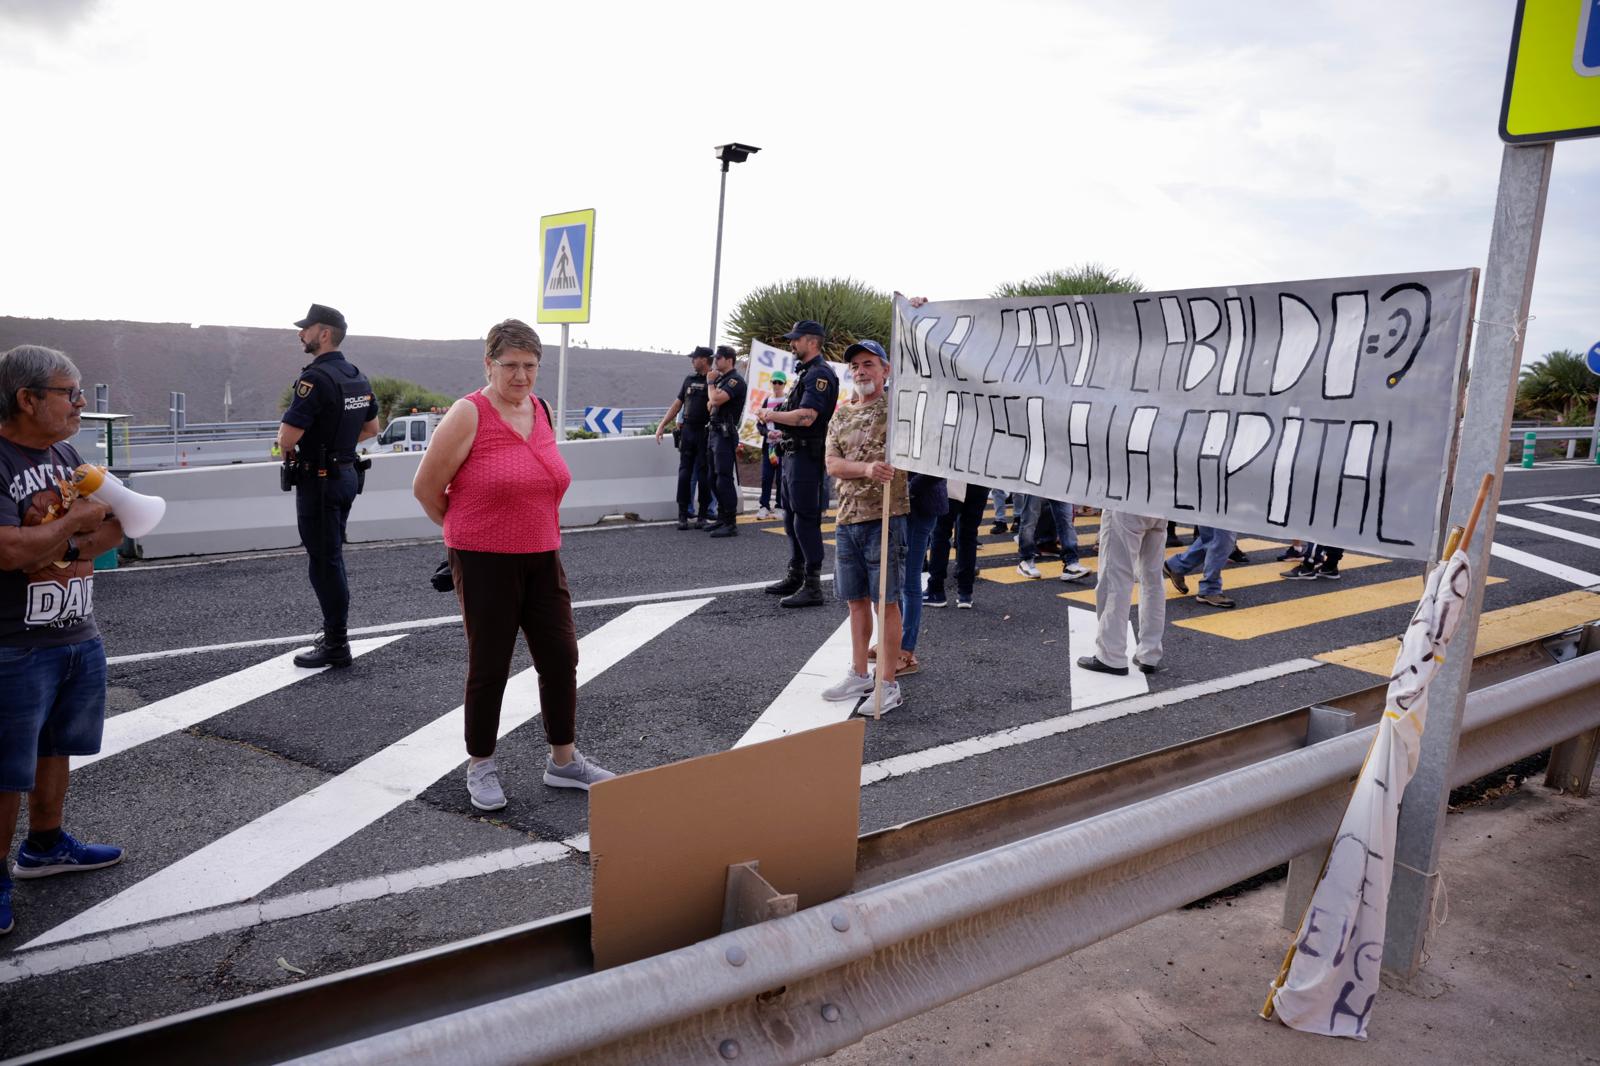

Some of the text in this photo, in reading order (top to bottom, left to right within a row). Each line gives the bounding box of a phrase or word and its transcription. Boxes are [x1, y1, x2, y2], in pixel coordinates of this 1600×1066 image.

[939, 315, 975, 381] AL
[1066, 401, 1092, 497] A
[1105, 404, 1160, 503] LA
[1173, 408, 1415, 546] CAPITAL
